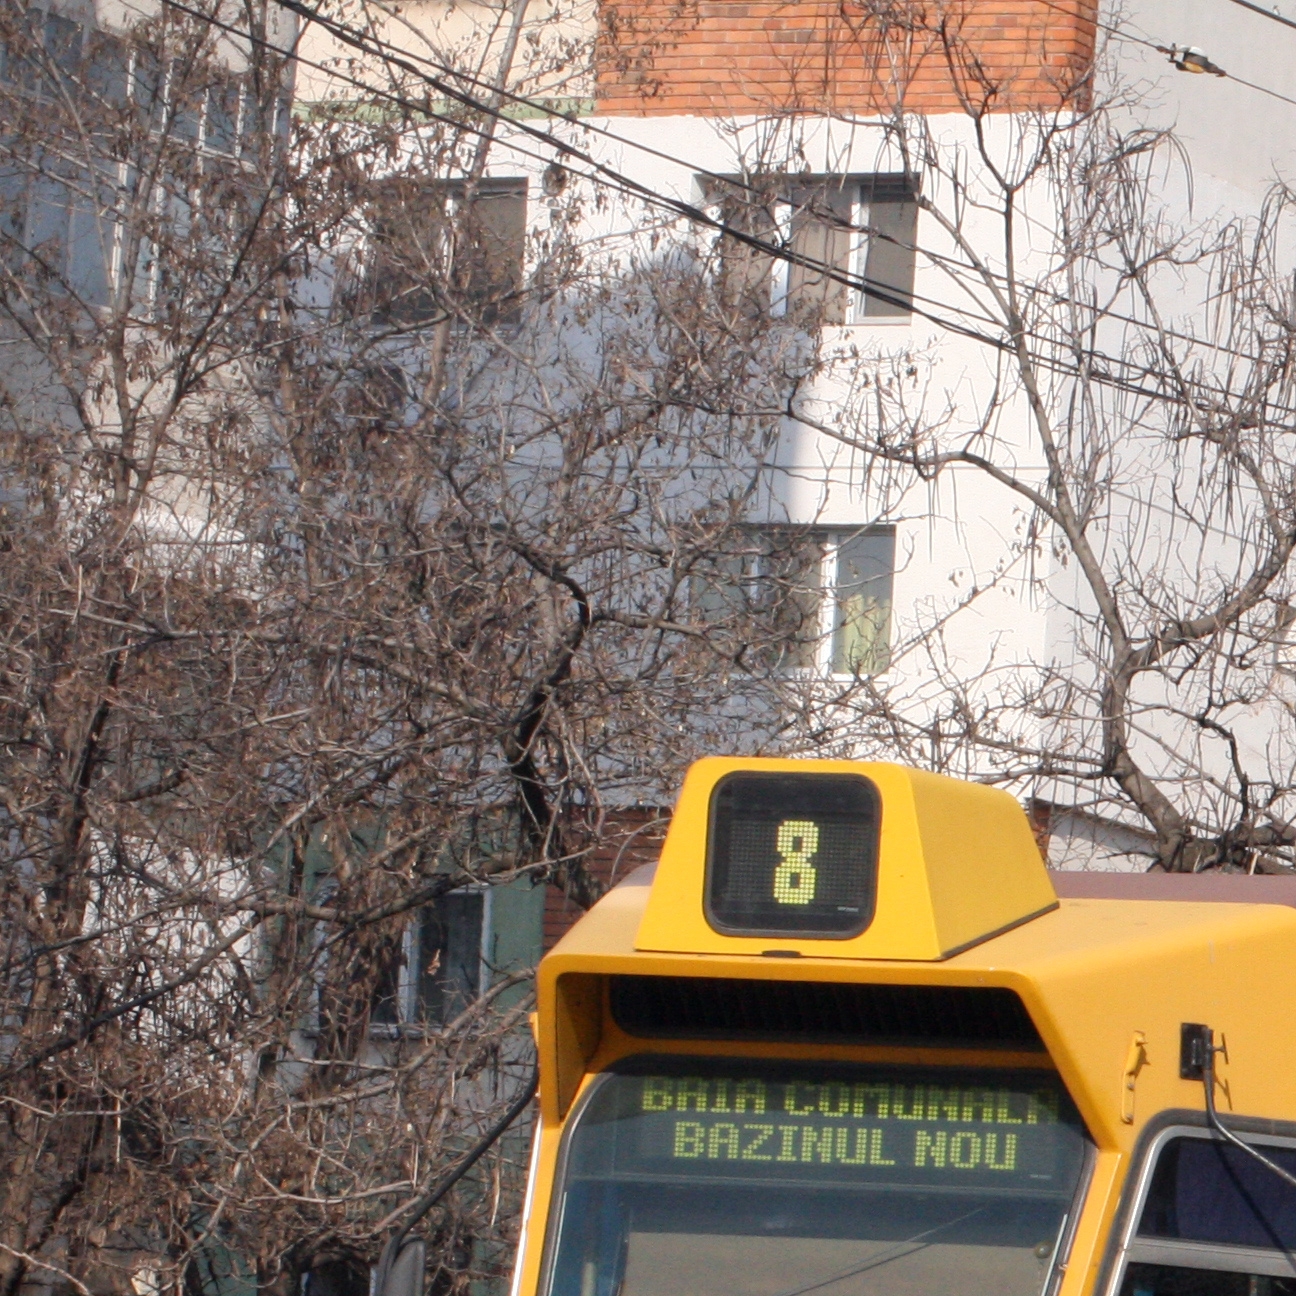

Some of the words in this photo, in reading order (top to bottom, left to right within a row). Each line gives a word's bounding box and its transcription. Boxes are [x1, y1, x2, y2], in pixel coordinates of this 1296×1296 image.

[772, 820, 819, 905] 8
[642, 1076, 767, 1115] BAIA
[673, 1120, 896, 1166] BAZINUL
[914, 1130, 1018, 1171] NOU
